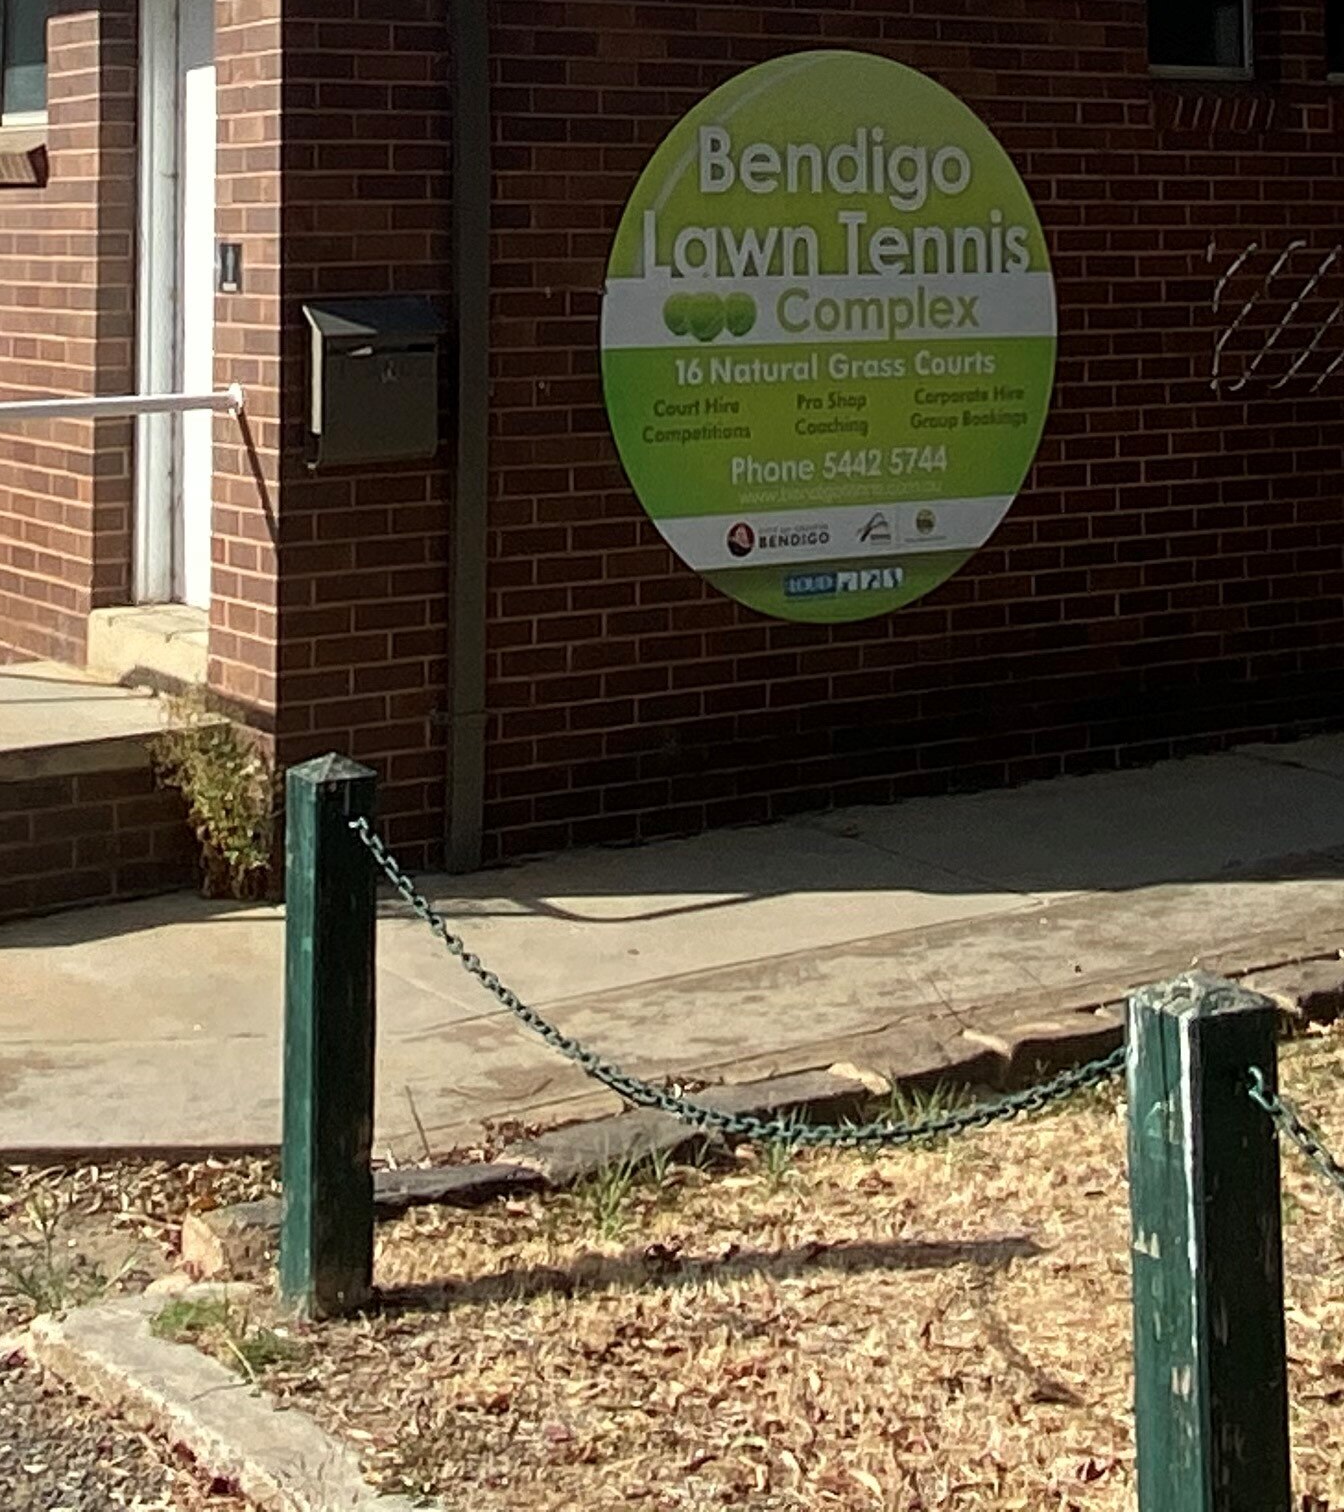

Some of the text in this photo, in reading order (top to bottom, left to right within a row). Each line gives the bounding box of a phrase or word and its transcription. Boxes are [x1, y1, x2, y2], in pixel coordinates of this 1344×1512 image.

[698, 125, 972, 211] Bendigo
[642, 209, 1030, 280] Lawn Tennis
[776, 286, 980, 341] Complex
[674, 350, 997, 386] 16 Natural Grass Courts
[653, 396, 740, 419] Court Hire
[796, 390, 868, 413] Pro Shop
[913, 386, 1026, 408] Corporate Hire
[794, 416, 869, 438] Coaching
[910, 408, 1029, 431] Group Bookings
[641, 424, 752, 445] Competitions
[730, 444, 948, 486] Phone 5442 5744
[759, 531, 829, 549] BENDIGO
